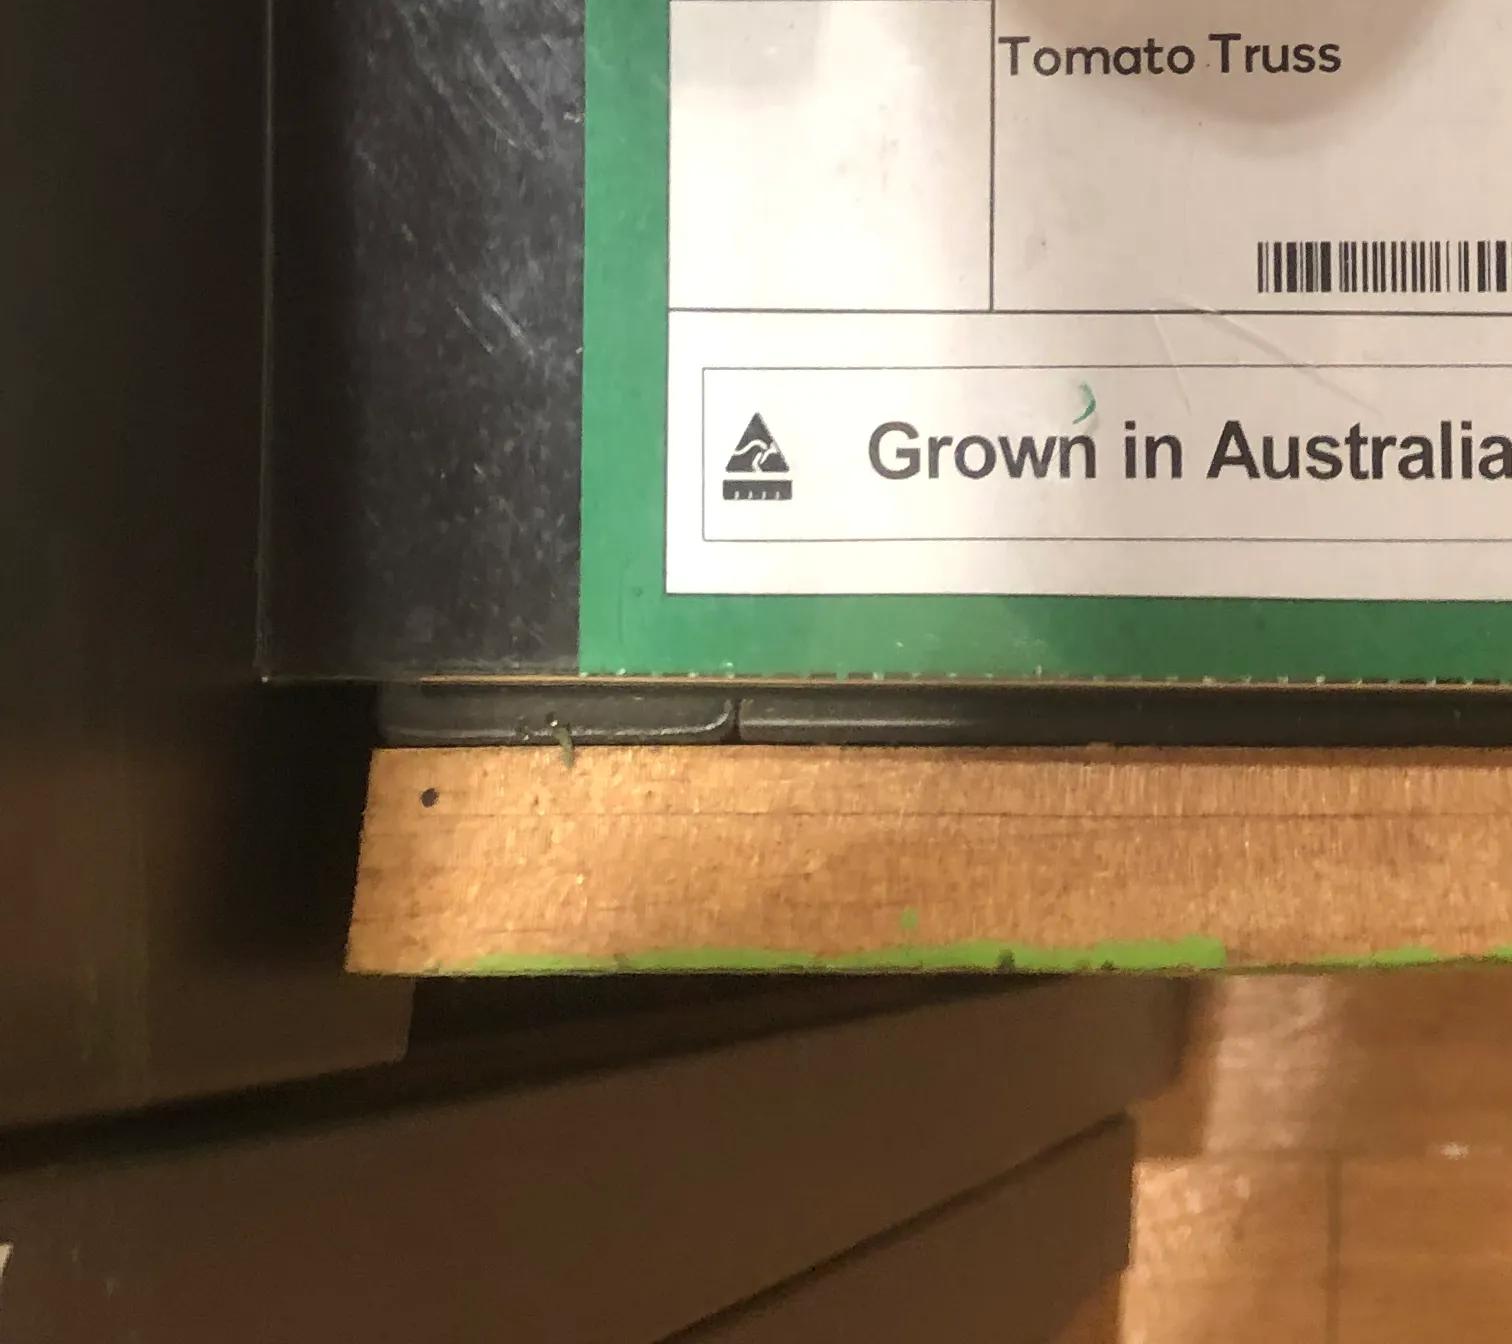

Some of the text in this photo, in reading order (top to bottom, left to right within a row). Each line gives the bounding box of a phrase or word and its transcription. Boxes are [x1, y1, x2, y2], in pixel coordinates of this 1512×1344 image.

[997, 32, 1343, 77] Tomato Truss
[868, 420, 1098, 481] Grown
[1123, 419, 1184, 480] in
